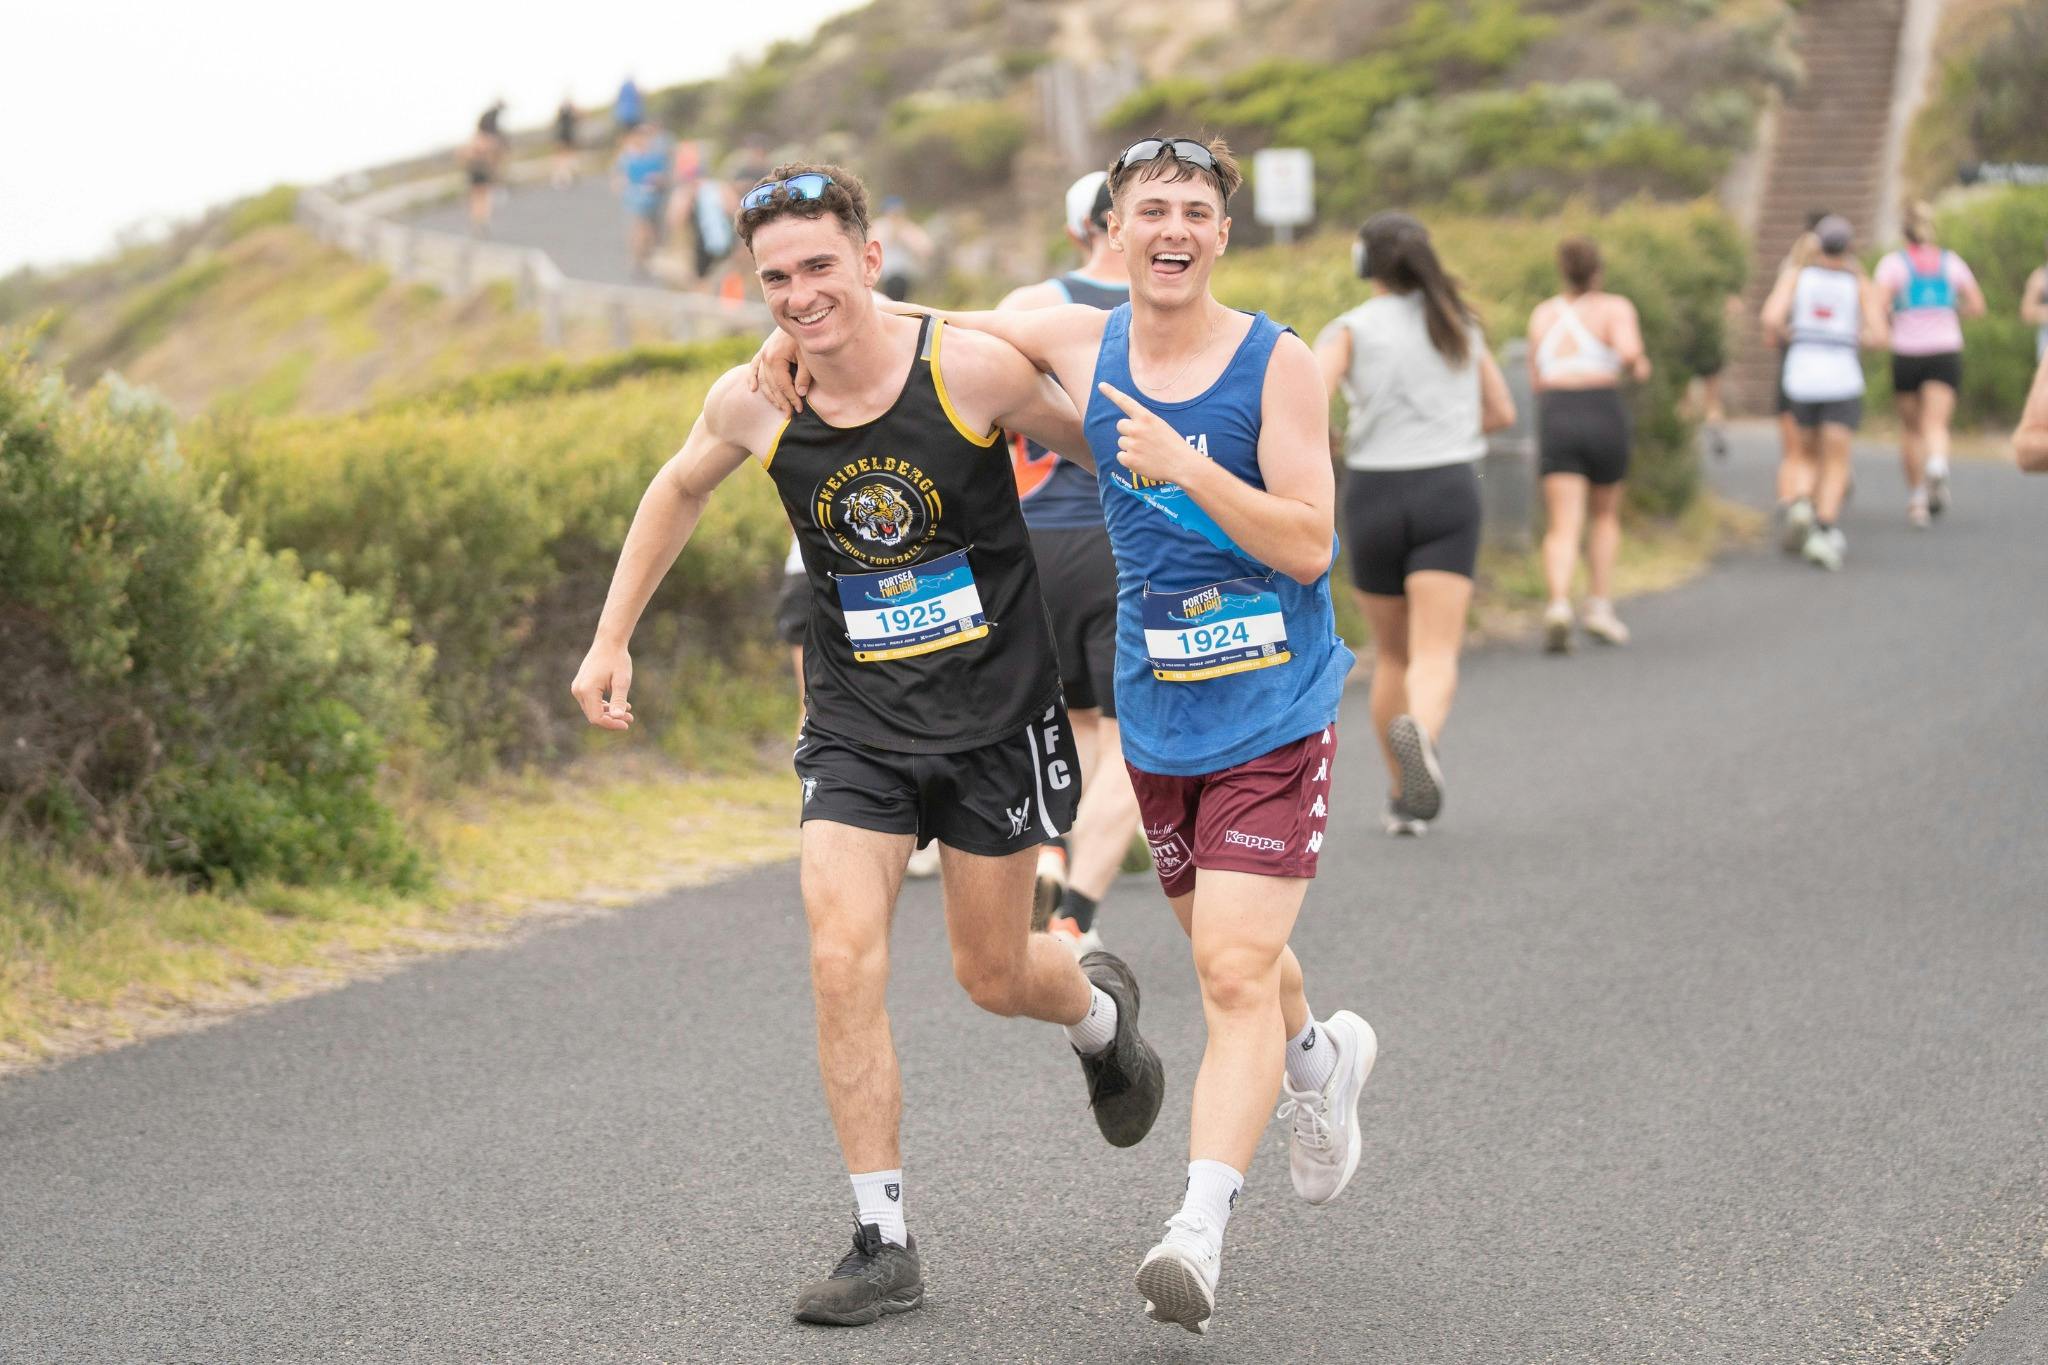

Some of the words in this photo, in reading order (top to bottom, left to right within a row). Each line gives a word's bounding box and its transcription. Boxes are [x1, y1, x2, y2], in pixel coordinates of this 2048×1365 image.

[819, 457, 935, 502] HEIDELBERG
[869, 544, 922, 565] FOOTBALL
[878, 569, 914, 590] PORTSEA
[880, 578, 918, 599] TWILIGHT
[1182, 586, 1220, 610] PORTSEA
[1184, 595, 1222, 619] TWILIGHT
[876, 600, 946, 633] 1925
[1177, 621, 1250, 655] 1924
[1225, 830, 1285, 850] Kappa
